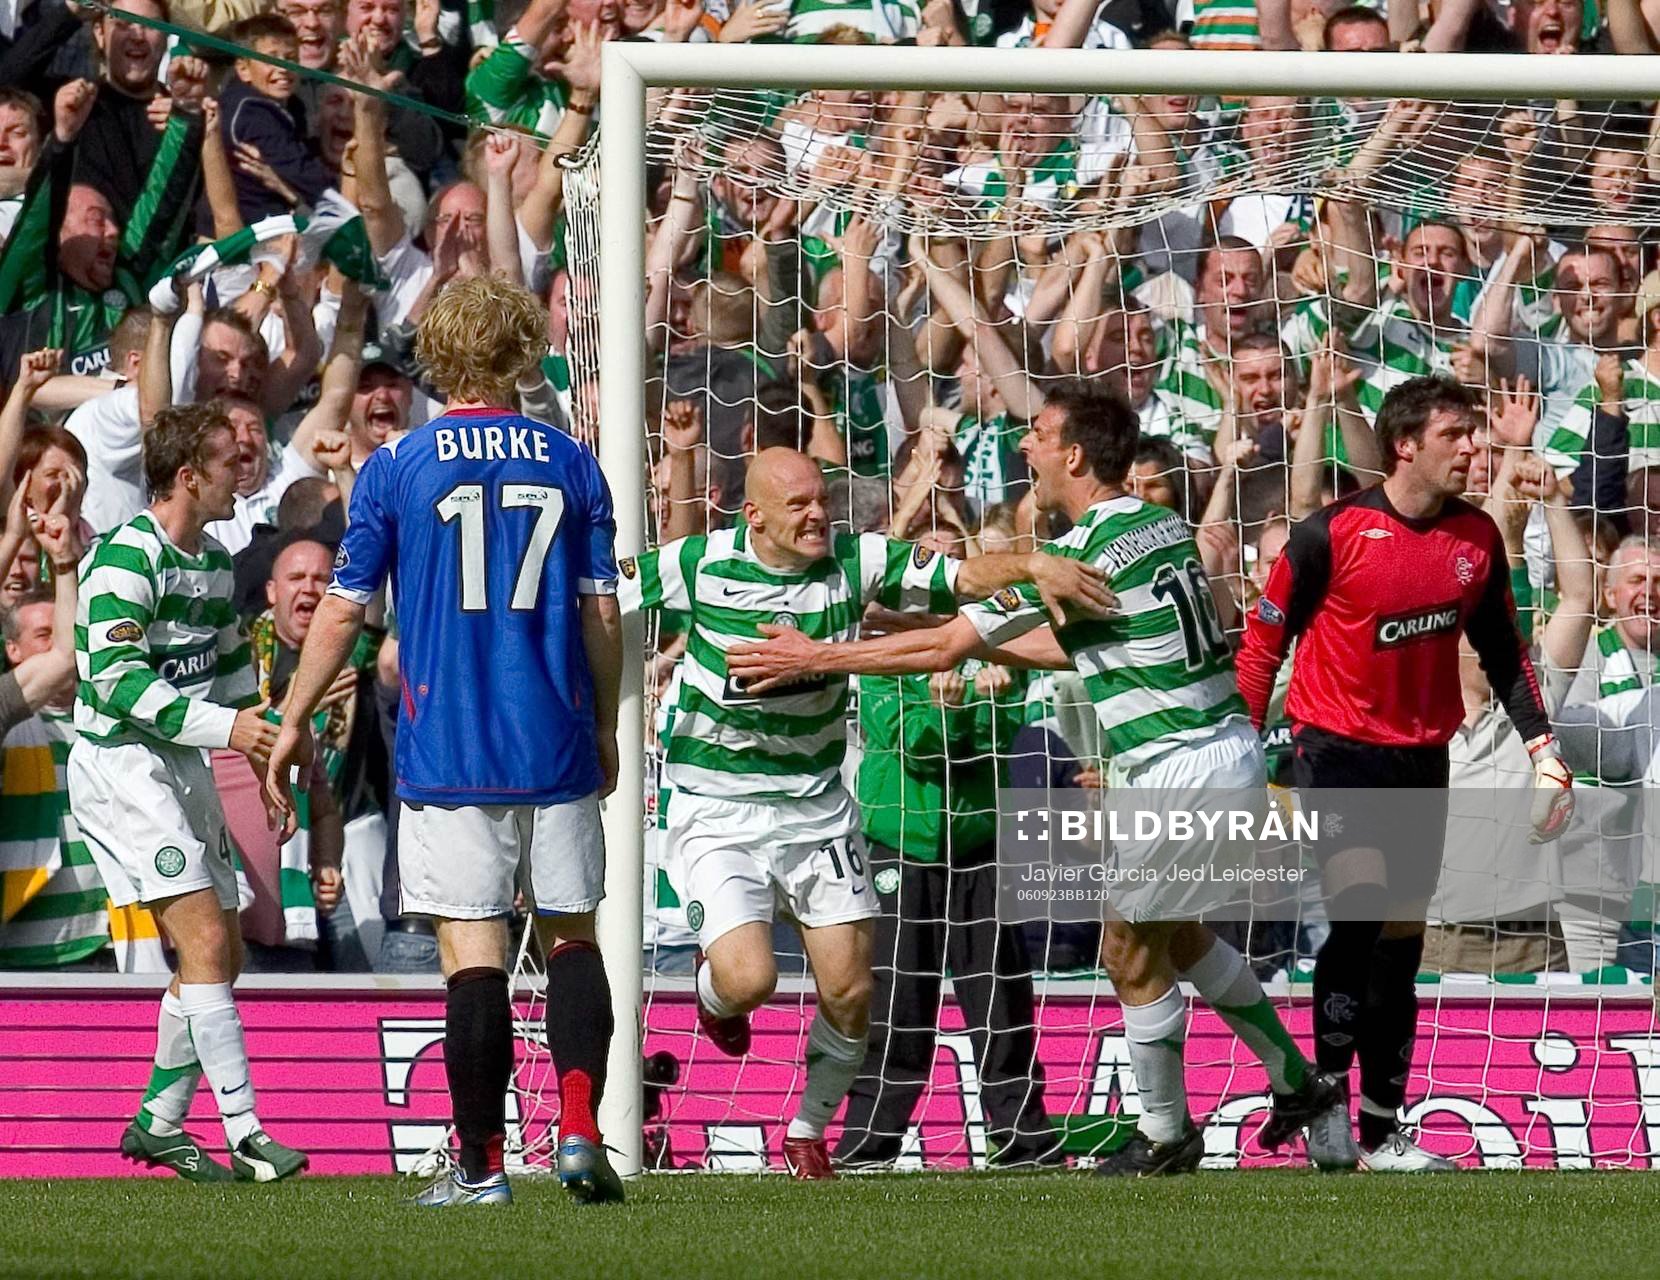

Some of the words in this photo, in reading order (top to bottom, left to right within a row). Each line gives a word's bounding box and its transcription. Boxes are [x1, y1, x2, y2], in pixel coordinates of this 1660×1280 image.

[72, 348, 111, 376] CARL
[435, 426, 550, 462] BURKE
[434, 482, 566, 612] 17
[1379, 609, 1457, 642] CARLING
[159, 645, 218, 681] CARLIN
[819, 836, 864, 879] 16
